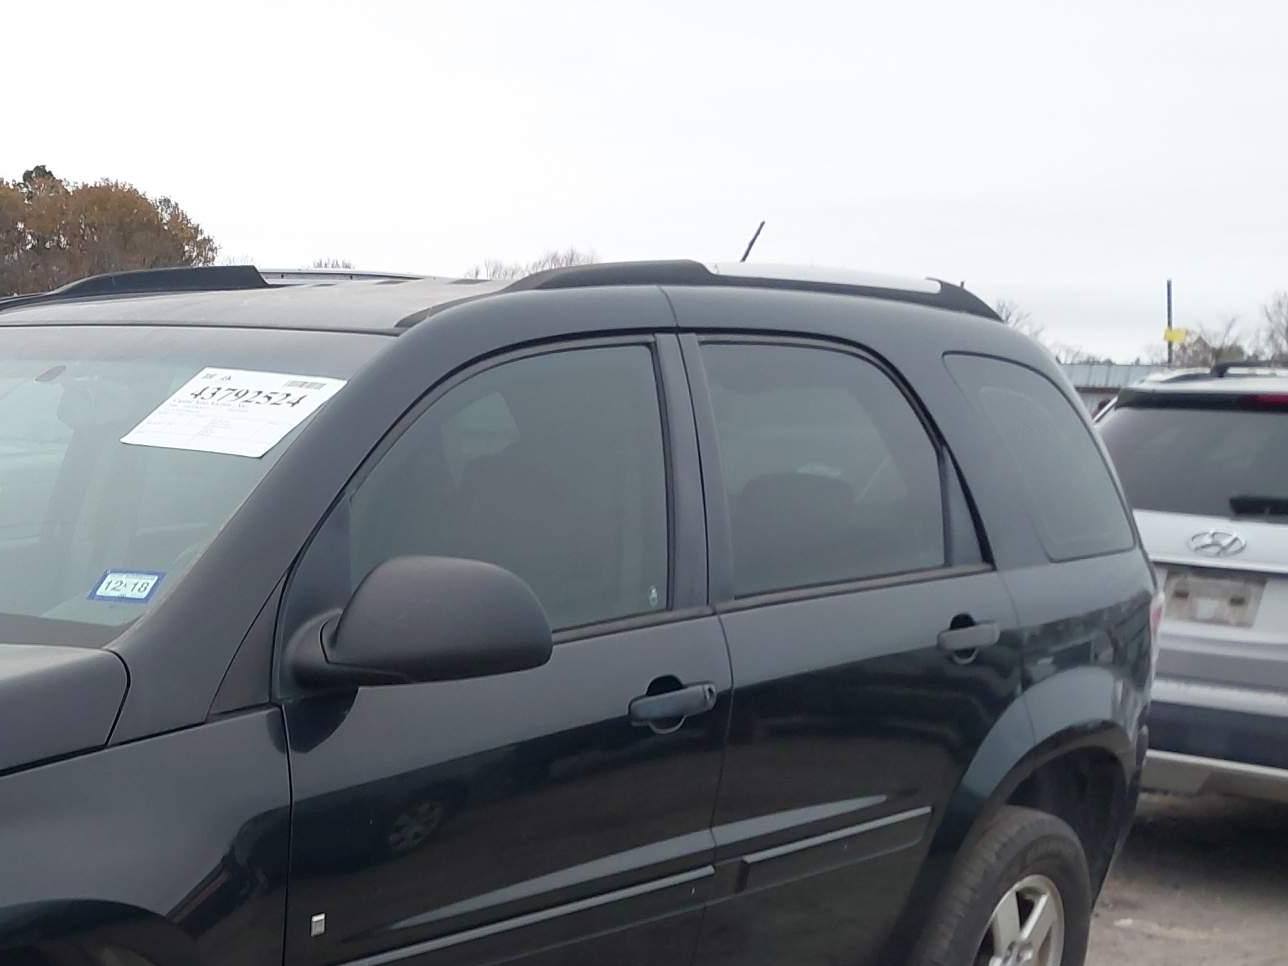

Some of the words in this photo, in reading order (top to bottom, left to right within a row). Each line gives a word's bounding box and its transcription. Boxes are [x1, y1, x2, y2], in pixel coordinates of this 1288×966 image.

[190, 385, 308, 408] 43792524
[104, 579, 123, 592] 12
[130, 580, 150, 593] 18
